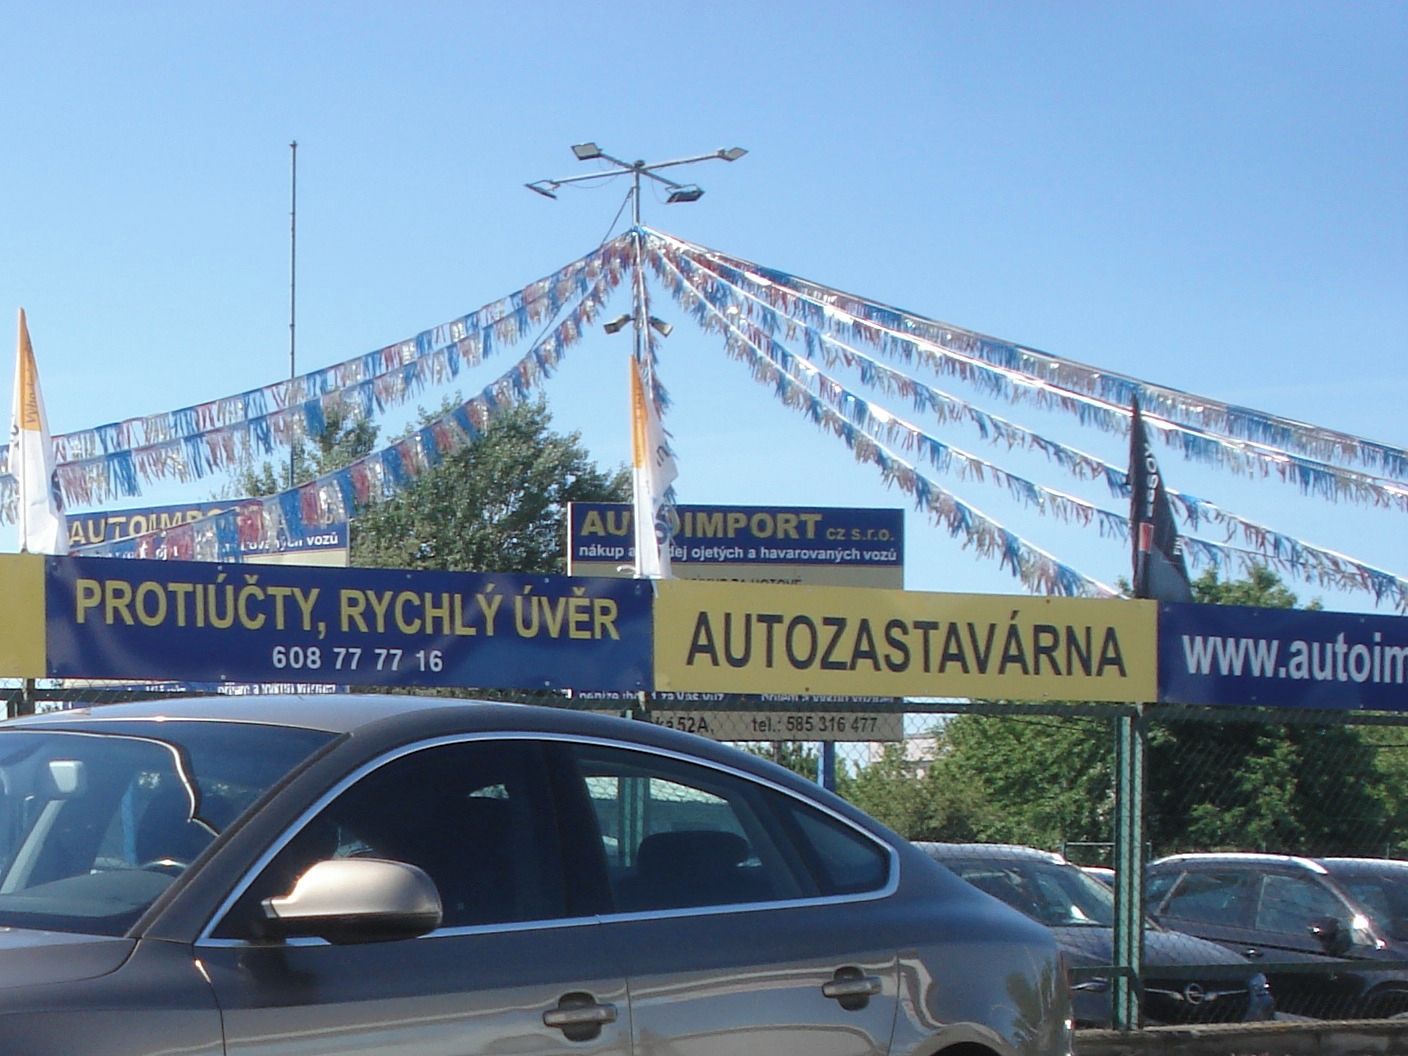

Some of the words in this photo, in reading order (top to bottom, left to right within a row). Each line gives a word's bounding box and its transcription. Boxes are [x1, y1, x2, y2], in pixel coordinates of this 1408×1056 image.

[580, 510, 823, 541] AUIMPORT
[826, 528, 845, 541] cz
[851, 528, 895, 542] s.r.o.
[579, 545, 625, 561] nákup
[691, 546, 744, 562] ojetých
[747, 550, 757, 560] a
[760, 546, 862, 563] havarovaných
[864, 548, 898, 562] vozů
[75, 573, 327, 640] PROTIÚČTY,
[339, 583, 503, 637] RYCHLÝ
[514, 584, 620, 641] ÚVĚR
[272, 646, 322, 671] 608
[333, 647, 362, 672] 77
[374, 648, 404, 672] 77
[415, 649, 444, 673] 16
[686, 611, 1128, 678] AUTOZASTAVÁRNA
[1182, 631, 1408, 684] www.autoim
[752, 716, 781, 732] tel.:
[786, 715, 814, 732] 585
[818, 716, 846, 733] 316
[850, 717, 878, 733] 477
